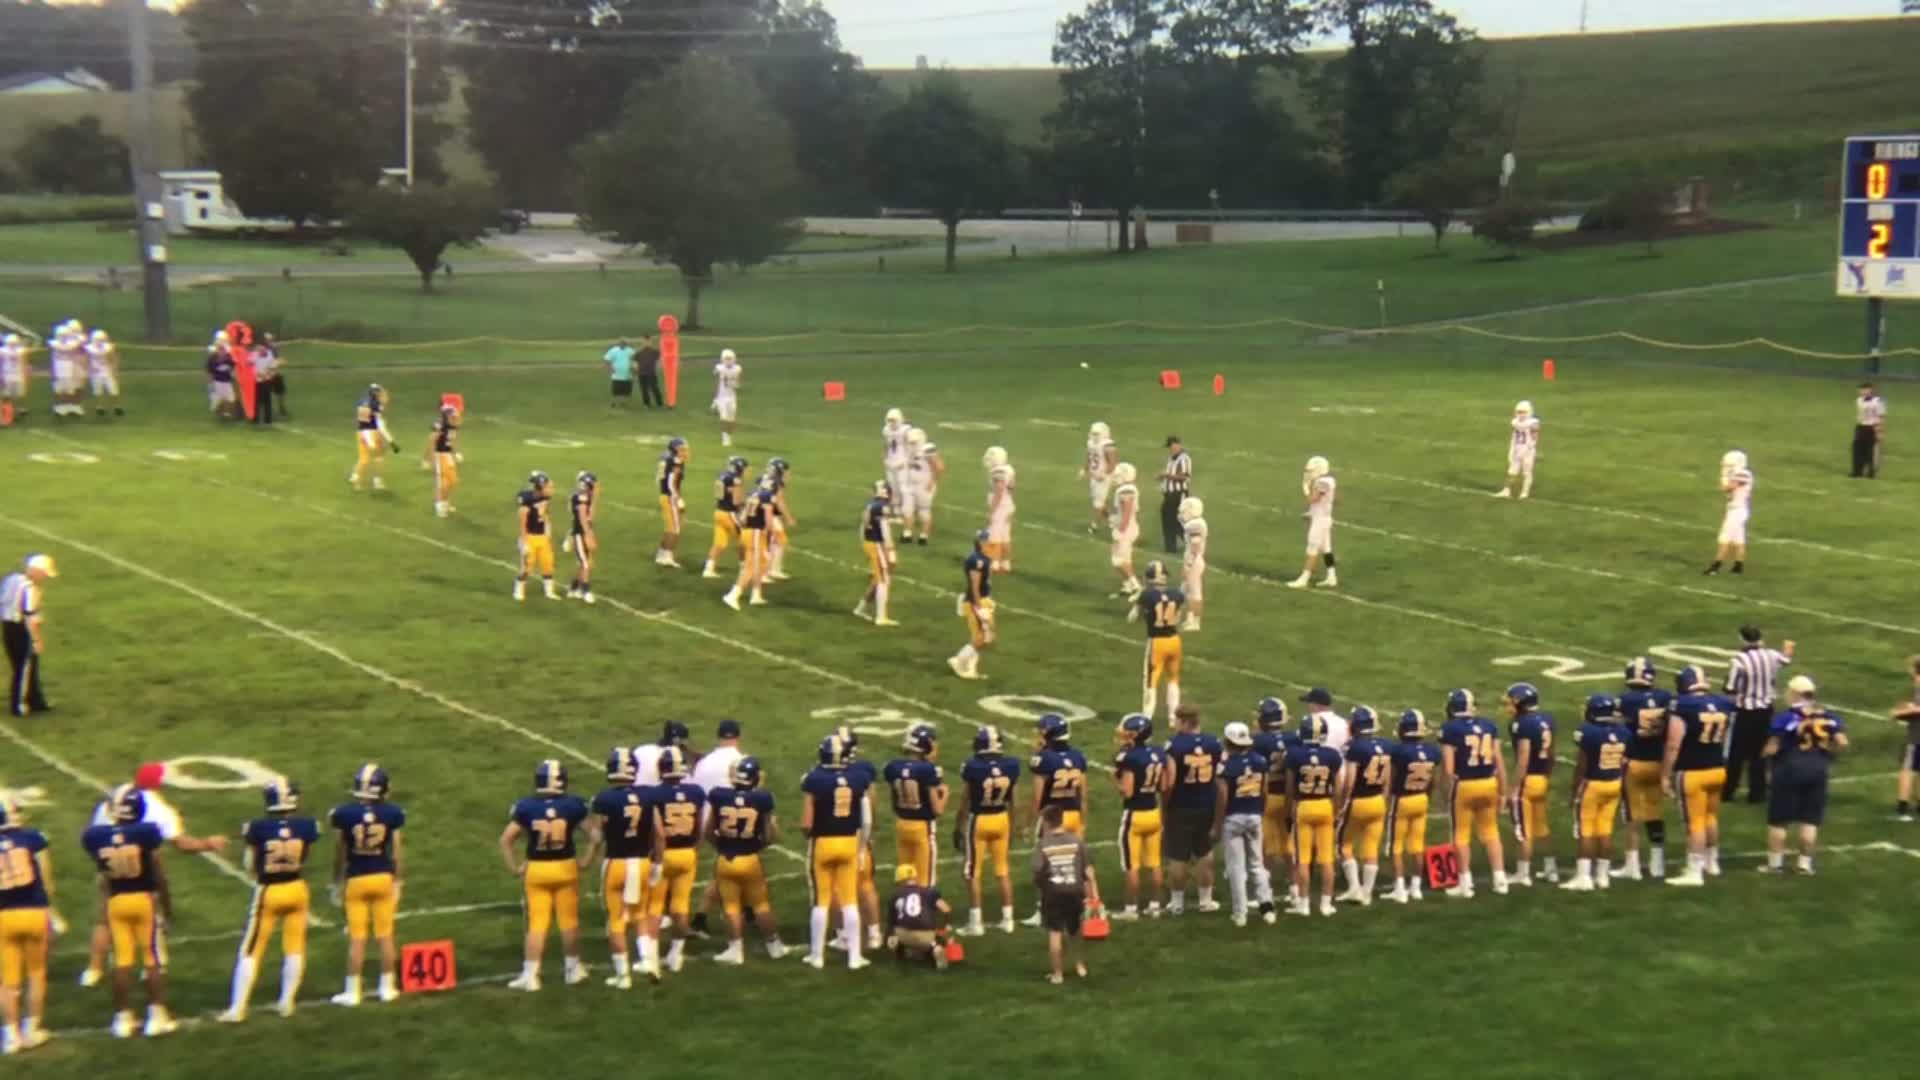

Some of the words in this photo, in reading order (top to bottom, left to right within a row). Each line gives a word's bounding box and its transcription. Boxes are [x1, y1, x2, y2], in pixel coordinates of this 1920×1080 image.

[1868, 164, 1888, 199] 0
[1869, 224, 1889, 259] 2
[624, 804, 643, 838] 7
[720, 806, 759, 839] 27
[1431, 850, 1459, 884] 30
[407, 951, 448, 985] 40
